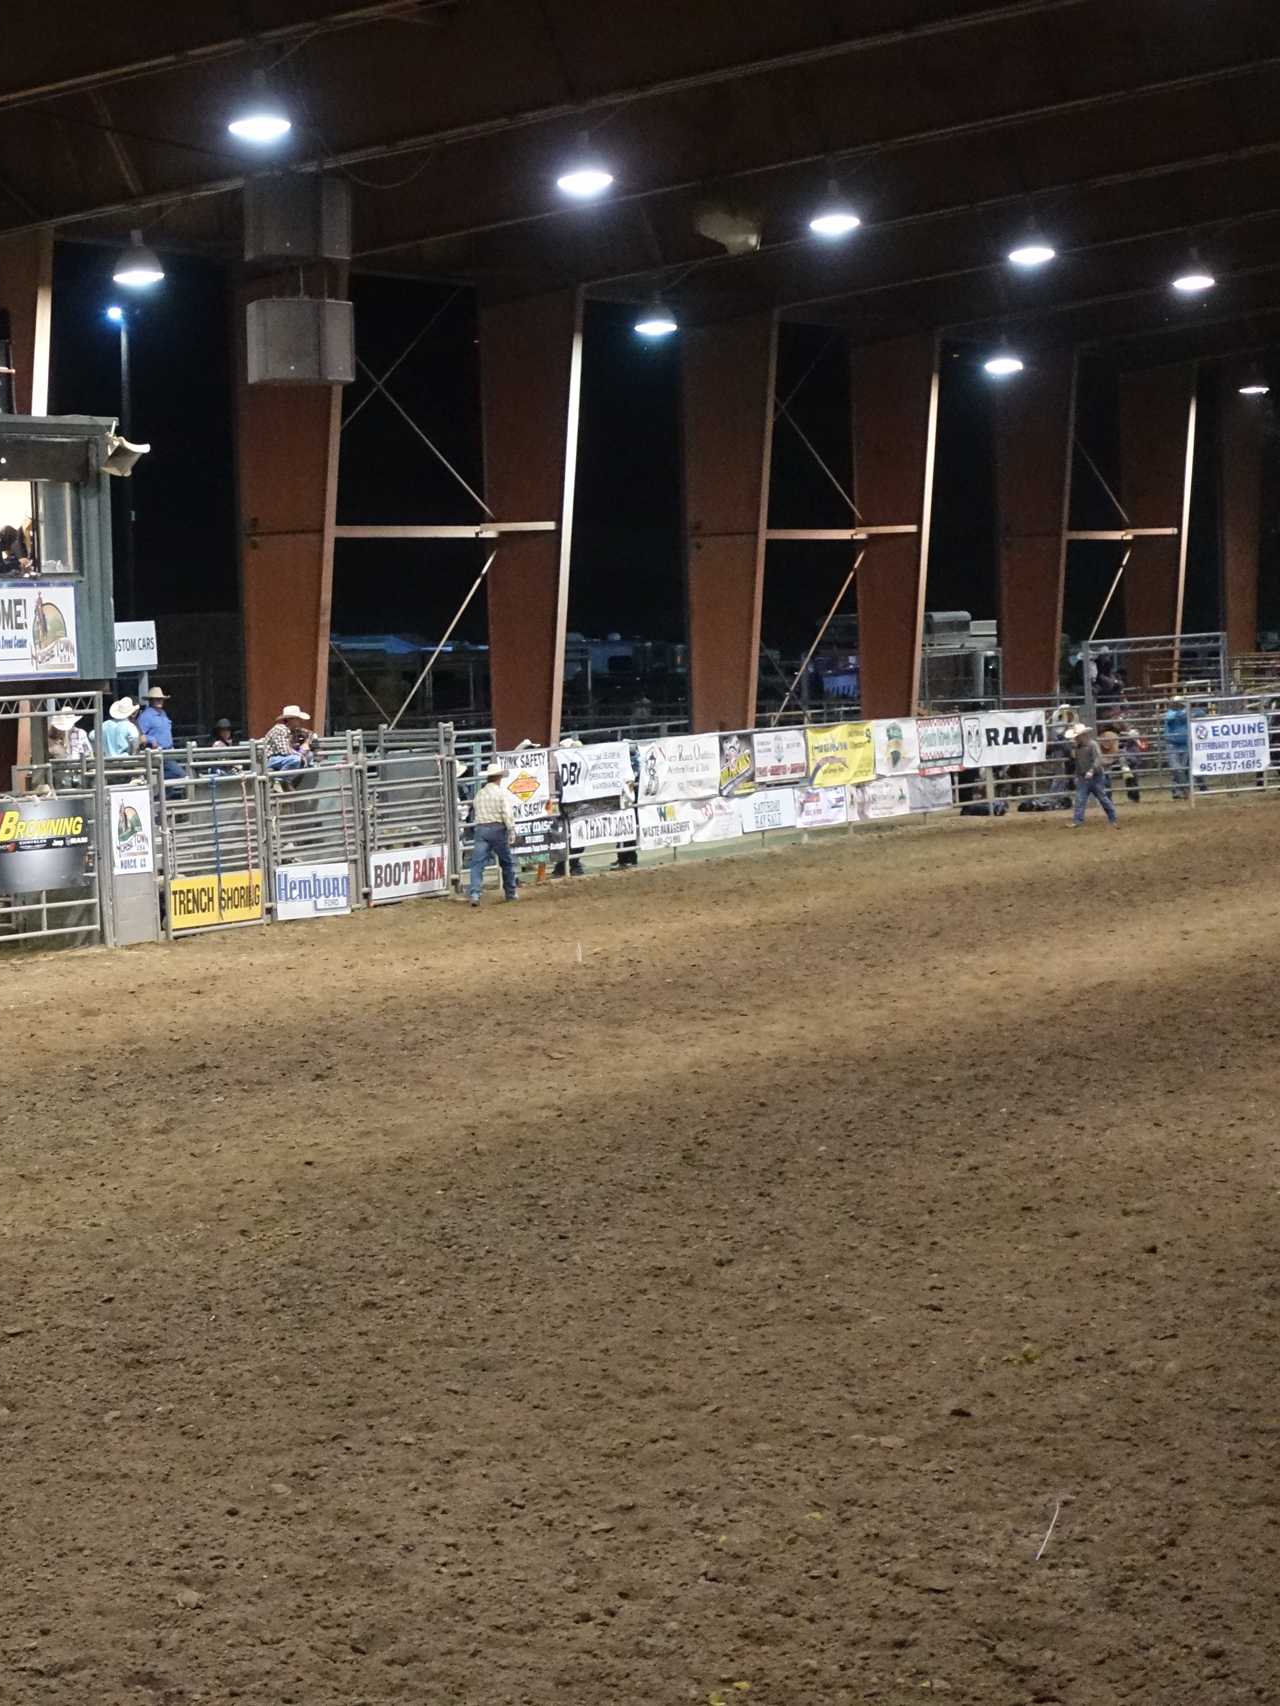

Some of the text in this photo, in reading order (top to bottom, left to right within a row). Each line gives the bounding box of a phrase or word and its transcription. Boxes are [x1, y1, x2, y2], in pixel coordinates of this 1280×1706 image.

[114, 636, 154, 652] USTOM CARS
[985, 725, 1043, 747] RAM
[1211, 722, 1265, 736] EQUINE
[499, 752, 546, 769] THINK SAFETY
[374, 856, 446, 888] BOOT BARN
[172, 884, 261, 916] TRENCH SHORING
